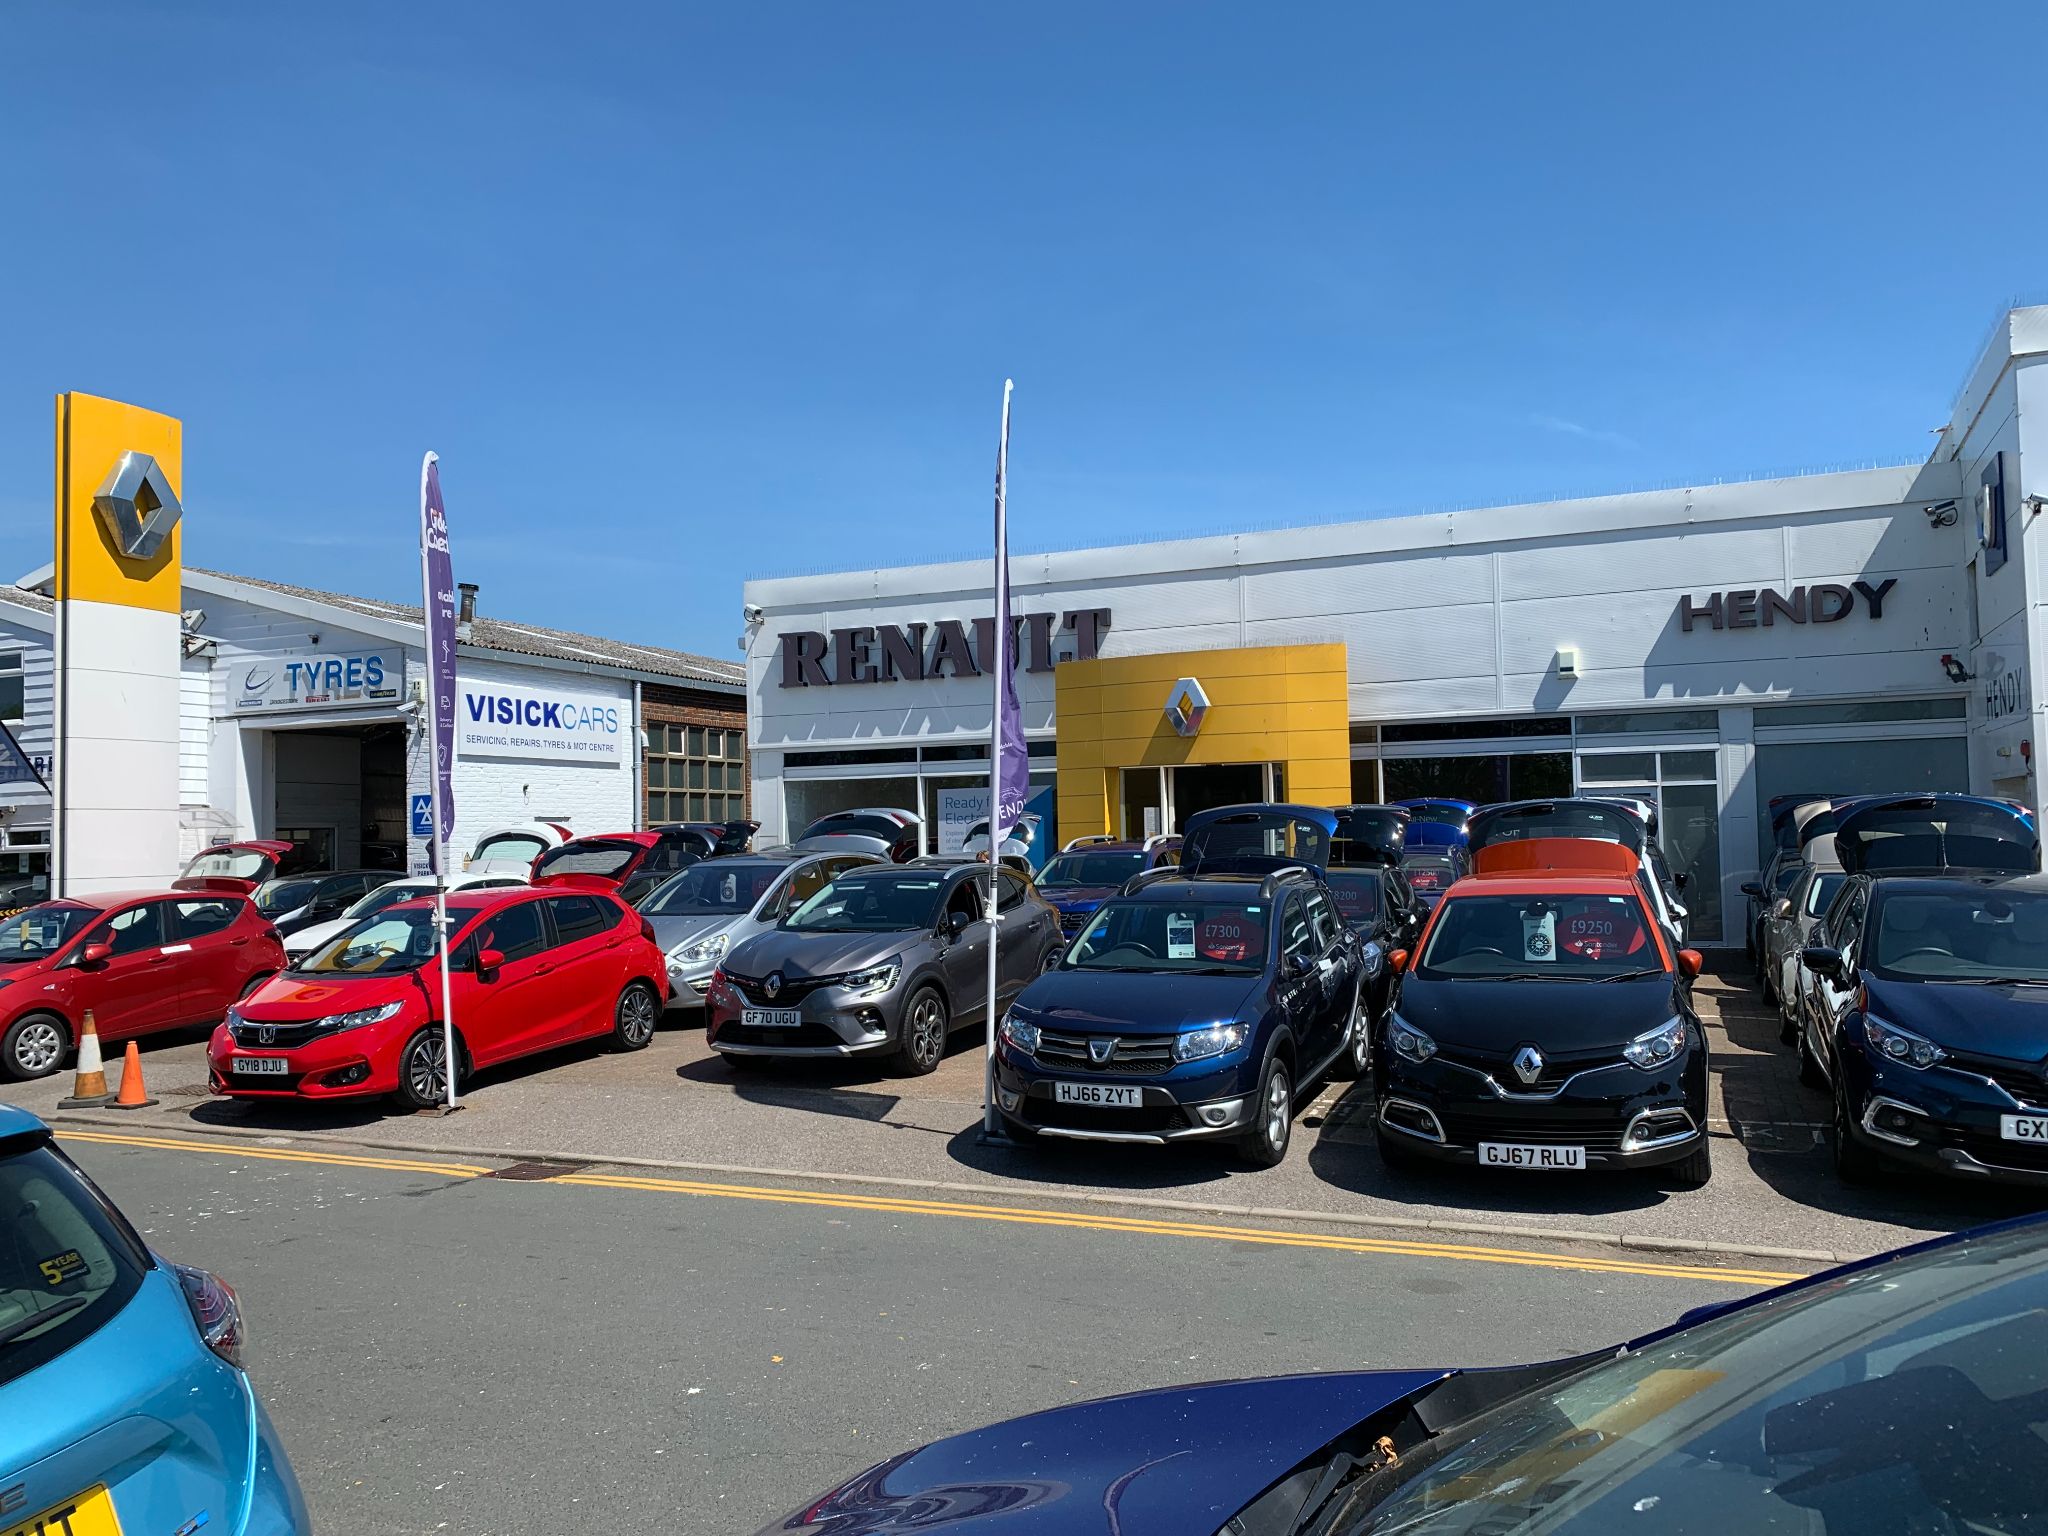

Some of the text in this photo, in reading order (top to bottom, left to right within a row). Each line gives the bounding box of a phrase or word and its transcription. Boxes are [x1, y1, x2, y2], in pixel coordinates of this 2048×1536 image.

[1681, 578, 1898, 632] HENDY
[778, 607, 1112, 689] RENAULT
[286, 655, 384, 691] TYRES
[1985, 666, 2022, 721] HENDY
[466, 734, 615, 753] SERVICING, REPAIRS, TYRES & MOT CENTRE
[945, 795, 984, 811] Ready
[998, 798, 1028, 820] END
[1205, 925, 1241, 938] £7300
[1571, 919, 1613, 935] £9250
[745, 1011, 797, 1025] GF70 UGU
[238, 1059, 282, 1072] GY18 DJU
[1062, 1085, 1135, 1104] HJ66 ZYT
[2015, 1119, 2048, 1139] GX
[1487, 1146, 1578, 1167] GJ67 RLU
[39, 1260, 63, 1285] 5
[52, 1252, 80, 1267] YEAR
